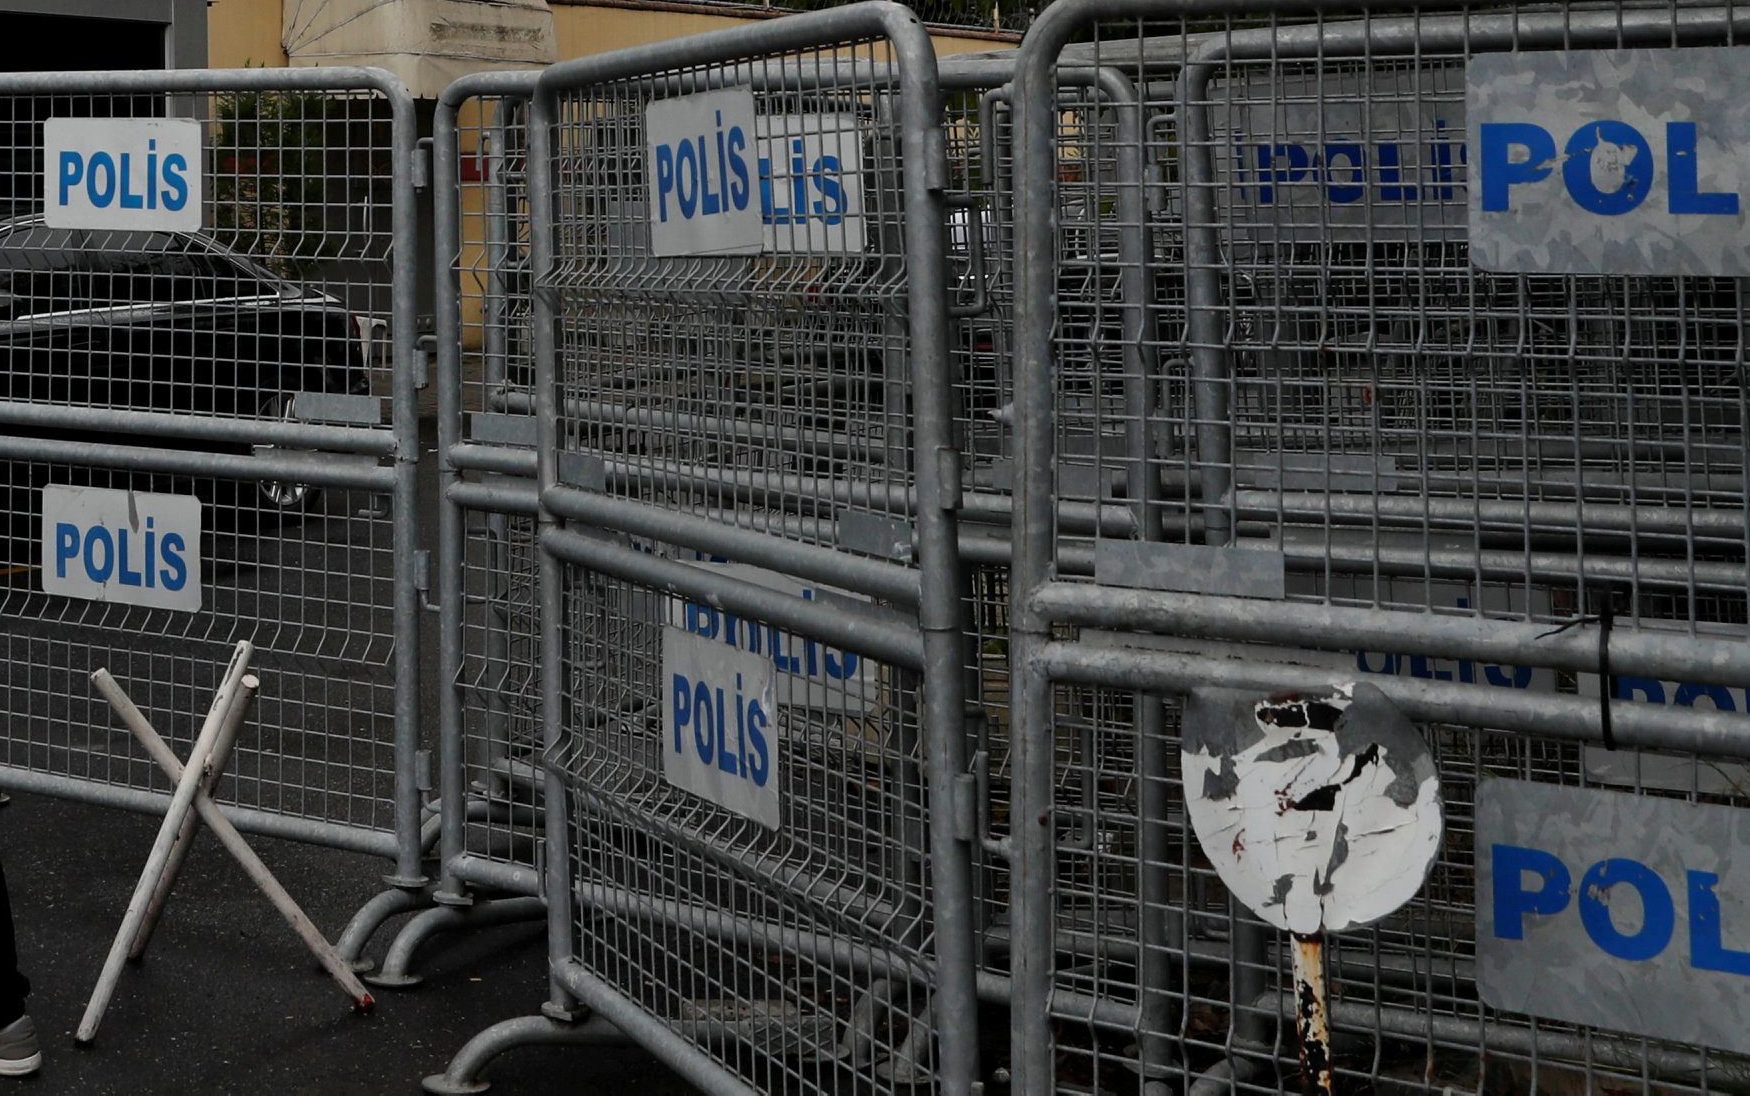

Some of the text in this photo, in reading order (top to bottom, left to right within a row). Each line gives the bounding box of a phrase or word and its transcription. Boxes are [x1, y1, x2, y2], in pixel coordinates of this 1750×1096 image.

[59, 139, 189, 212] POLİS
[655, 110, 750, 223] POLİS
[1258, 120, 1467, 204] POLİ
[1480, 119, 1740, 216] POL
[55, 516, 188, 592] POLİS
[672, 672, 770, 788] POLİS
